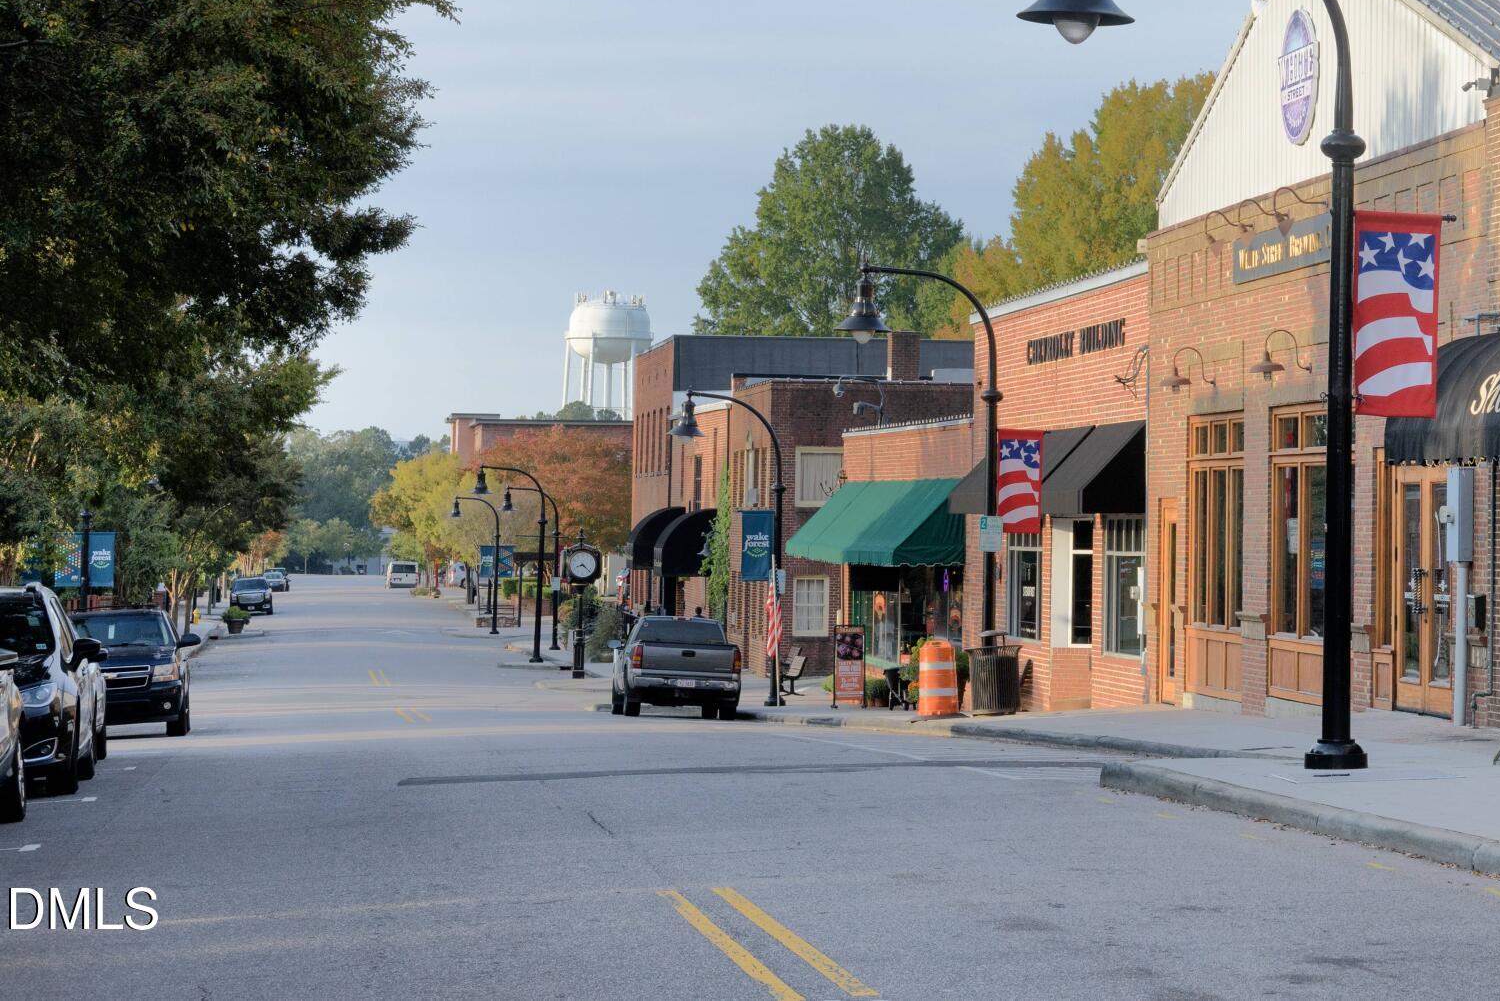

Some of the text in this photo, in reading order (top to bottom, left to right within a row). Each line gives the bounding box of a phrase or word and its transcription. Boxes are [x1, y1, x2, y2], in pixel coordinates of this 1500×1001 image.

[1287, 85, 1305, 101] STREET
[1027, 317, 1125, 366] CHEVROLET BUILDING
[746, 531, 769, 540] wake
[742, 539, 769, 551] forest
[92, 548, 111, 556] wake
[89, 555, 111, 565] forest
